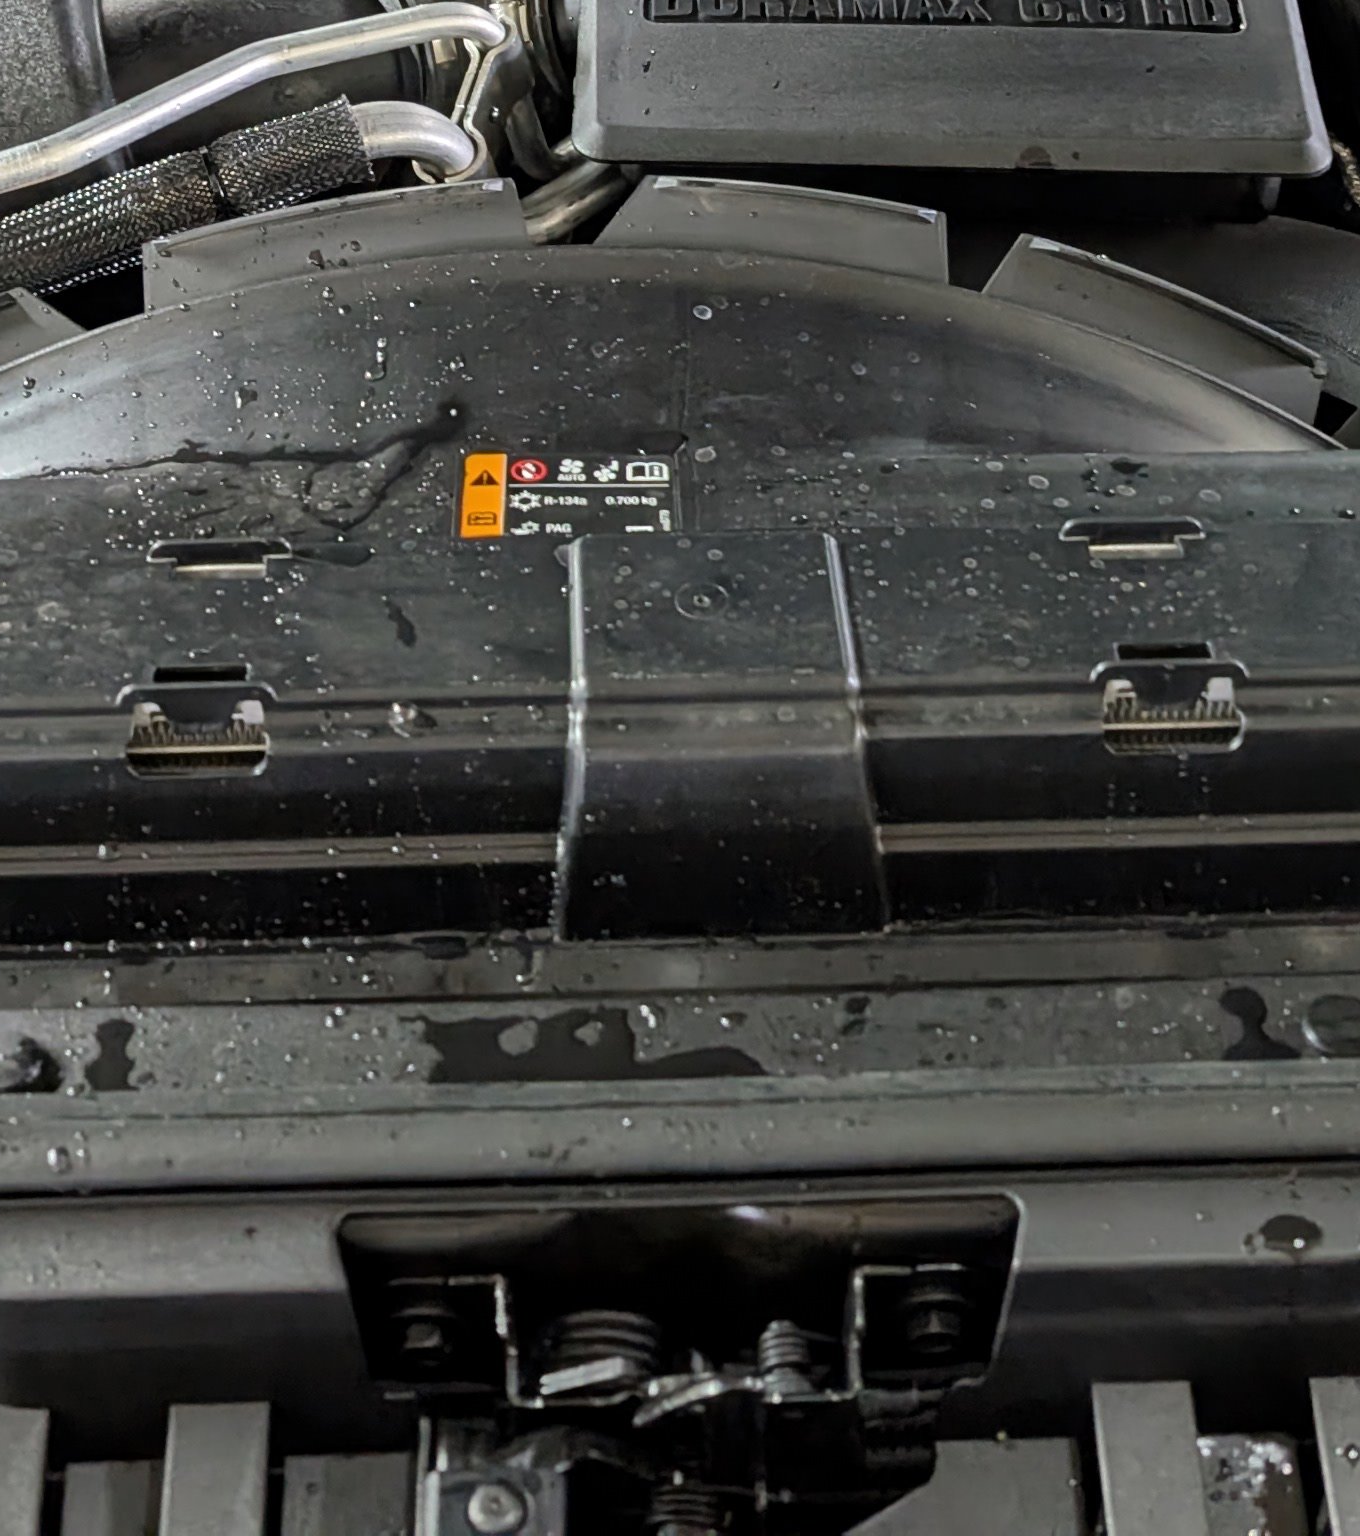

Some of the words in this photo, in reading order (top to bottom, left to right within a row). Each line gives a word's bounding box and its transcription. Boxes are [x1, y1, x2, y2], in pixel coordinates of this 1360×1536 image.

[557, 473, 587, 482] AUTO
[544, 495, 588, 505] R-134a
[640, 495, 658, 507] kg
[545, 523, 572, 533] PAG
